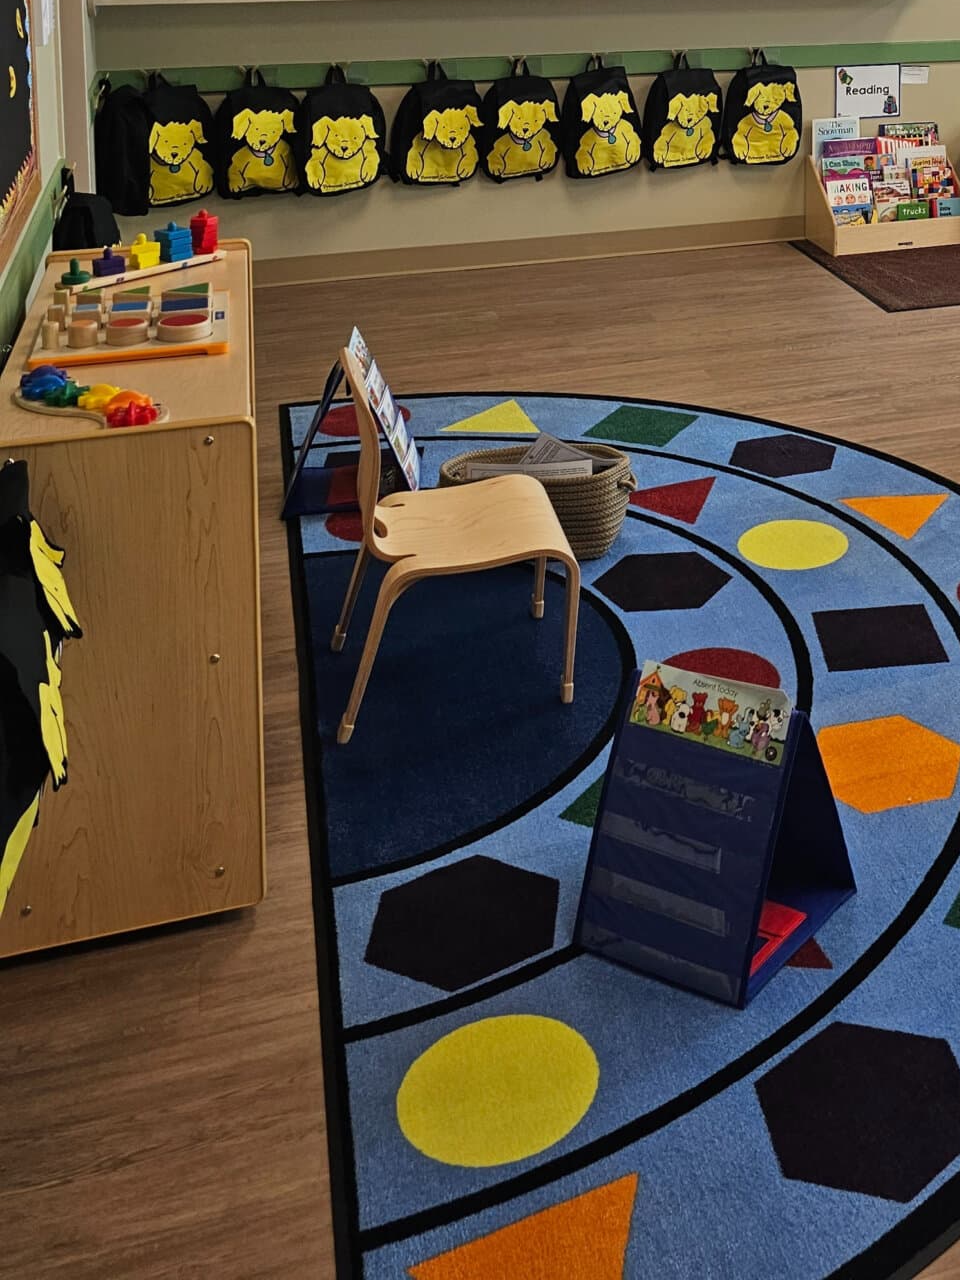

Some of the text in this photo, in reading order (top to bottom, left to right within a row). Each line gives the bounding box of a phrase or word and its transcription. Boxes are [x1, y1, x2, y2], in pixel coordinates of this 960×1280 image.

[845, 84, 890, 96] Reading
[817, 127, 854, 136] Snowman
[902, 206, 926, 216] trucks
[693, 678, 738, 698] Absent Today
